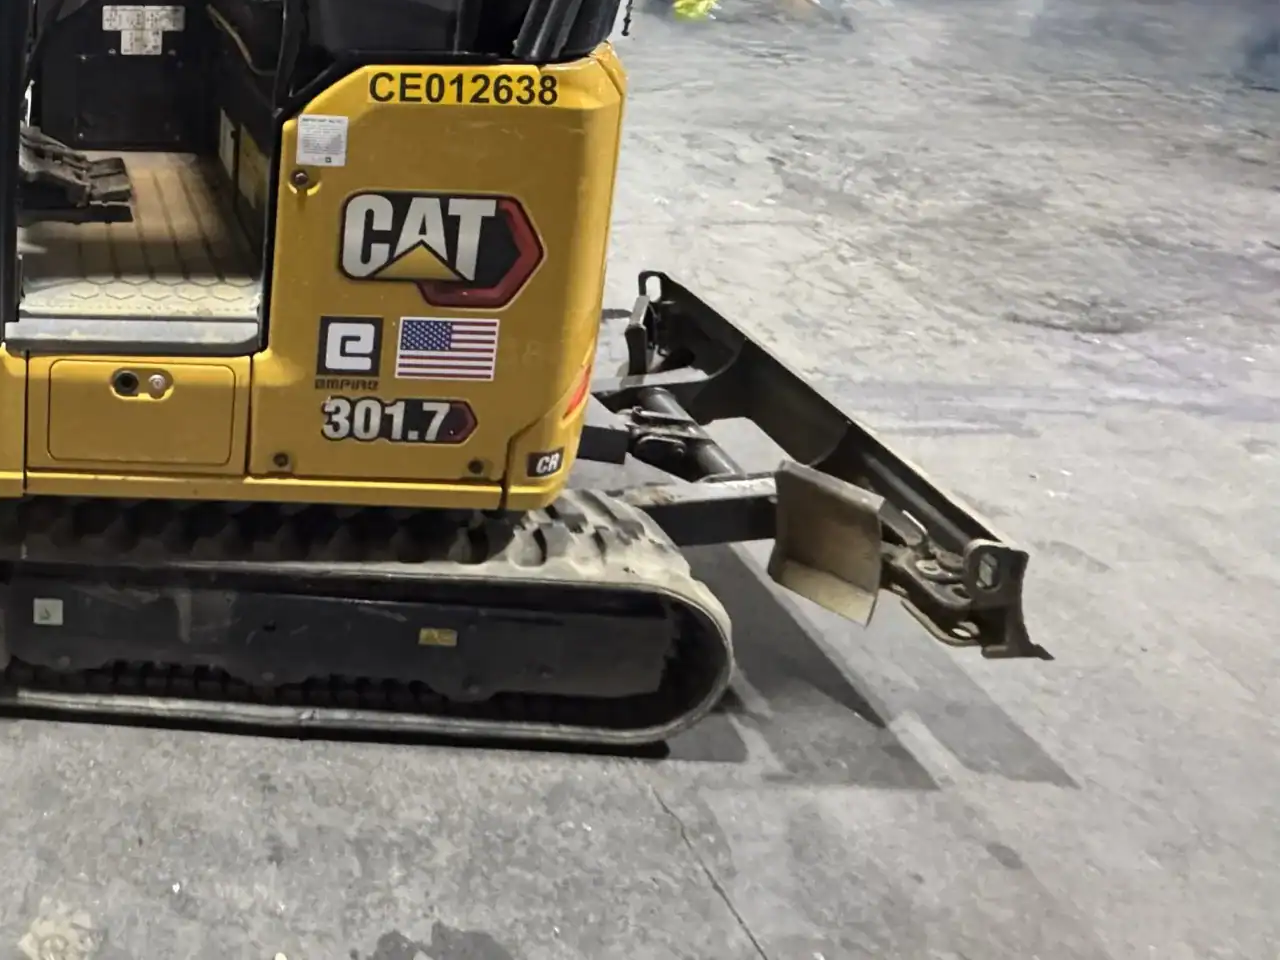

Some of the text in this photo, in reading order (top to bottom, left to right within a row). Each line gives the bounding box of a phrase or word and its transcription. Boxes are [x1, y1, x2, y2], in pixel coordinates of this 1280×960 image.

[369, 71, 558, 105] CE012638
[342, 194, 497, 281] CAT
[322, 398, 451, 441] 301.7
[536, 452, 560, 474] CR
